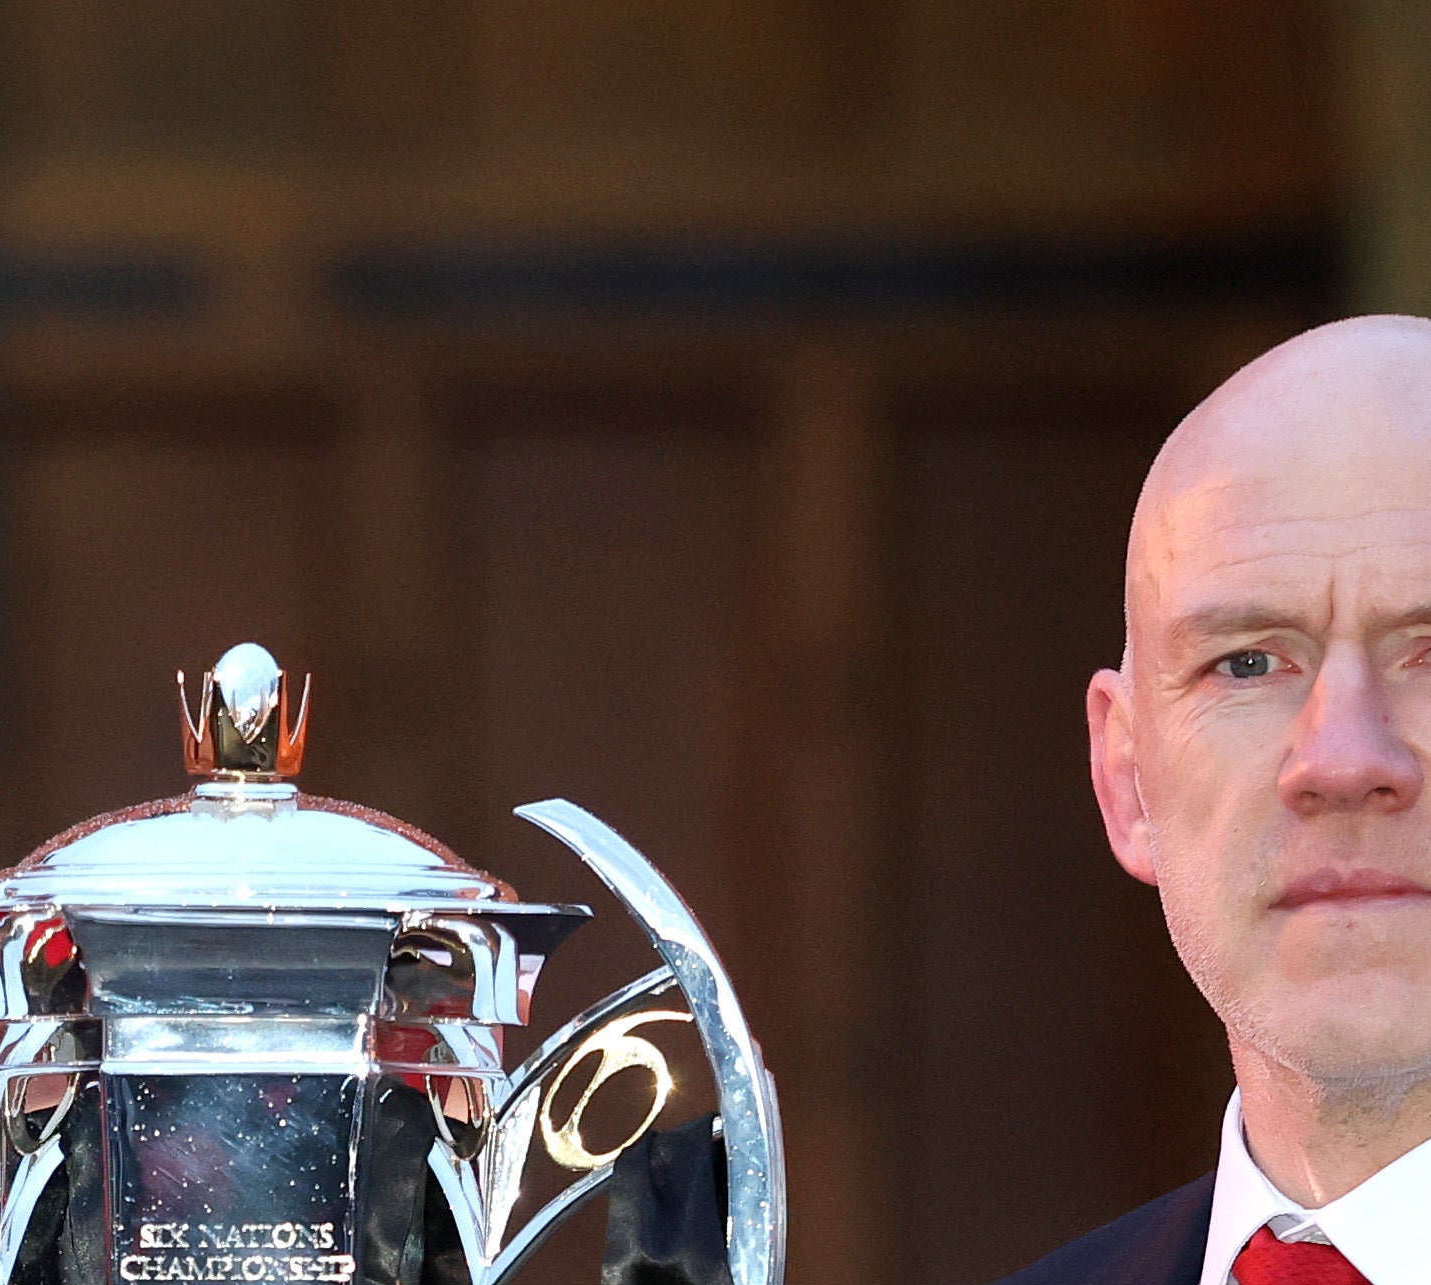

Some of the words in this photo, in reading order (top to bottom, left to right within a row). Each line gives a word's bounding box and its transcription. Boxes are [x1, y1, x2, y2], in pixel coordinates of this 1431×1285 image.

[140, 1223, 189, 1248] SIX
[198, 1223, 334, 1249] NATIONS
[119, 1255, 356, 1282] CHAMPIONSHIP
